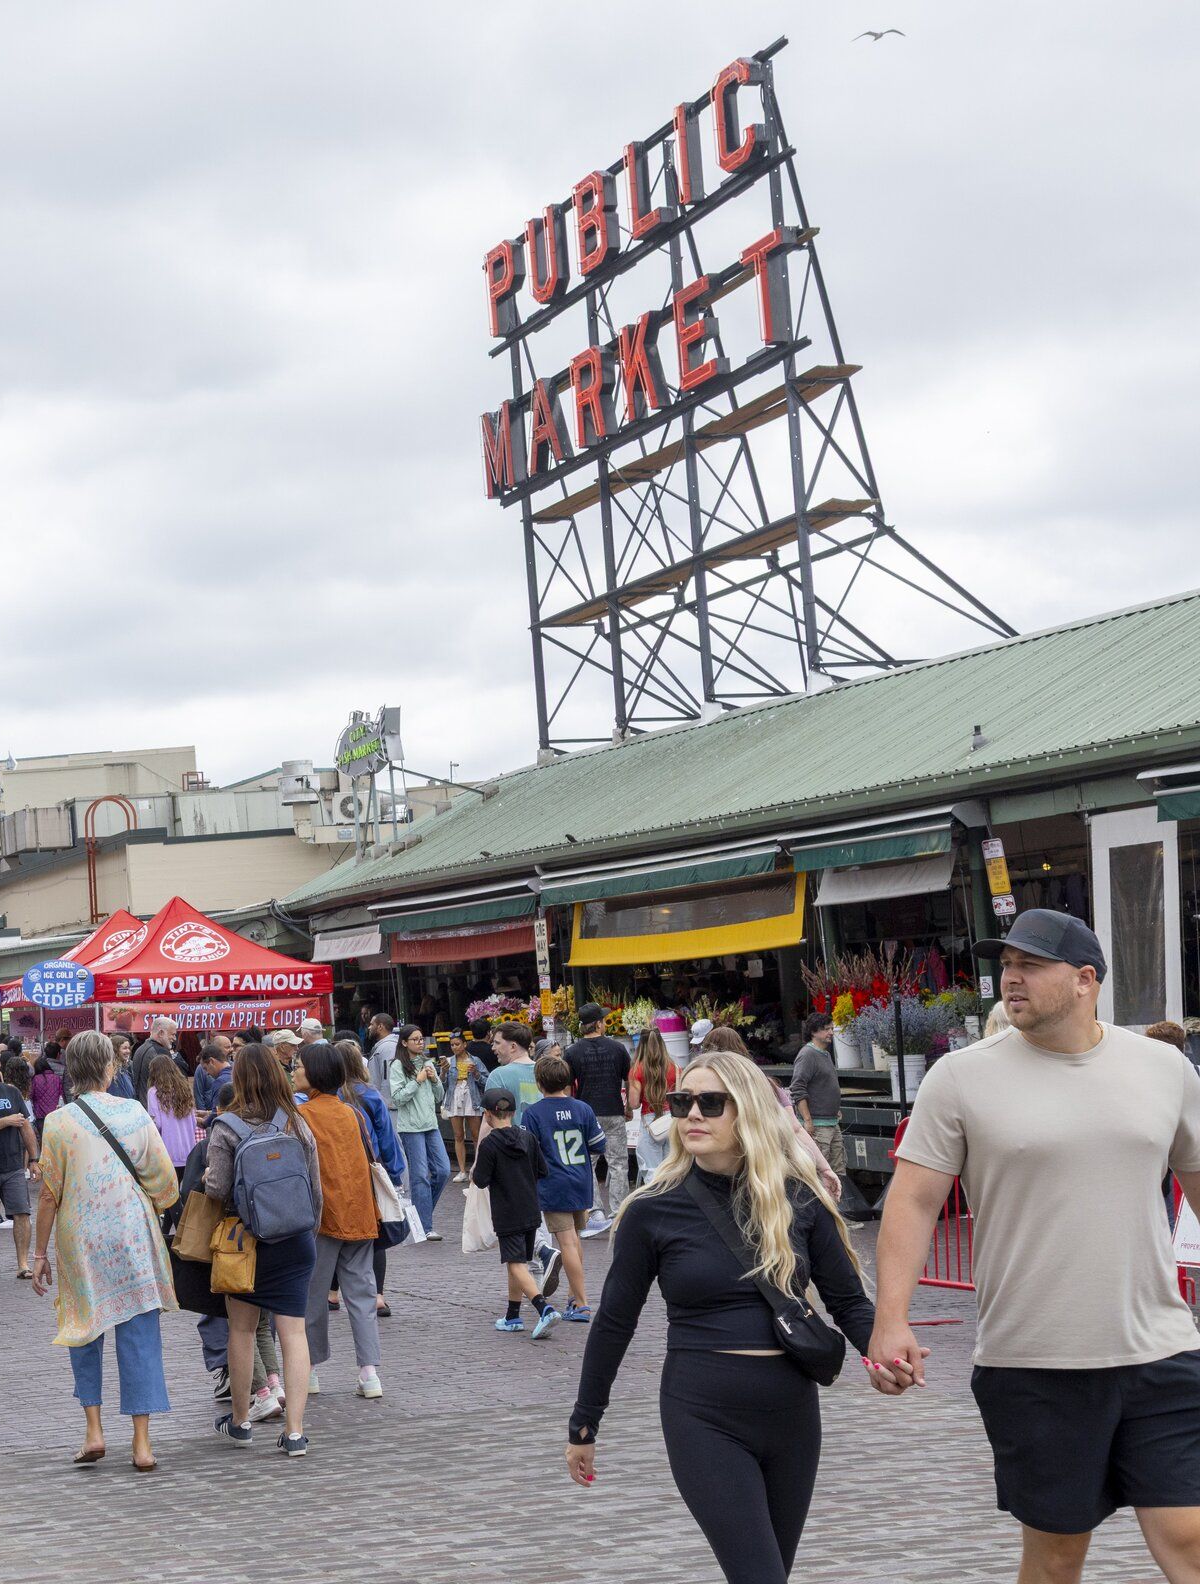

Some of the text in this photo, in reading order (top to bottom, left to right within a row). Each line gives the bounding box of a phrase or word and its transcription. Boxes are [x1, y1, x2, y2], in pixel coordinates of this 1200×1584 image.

[484, 56, 770, 338] PUBLIC
[480, 226, 792, 500] MARKET
[166, 923, 219, 941] TINY'S
[174, 951, 224, 961] ORGANIC
[43, 961, 76, 969] ORGANIC
[43, 971, 55, 979] ICE
[56, 971, 74, 979] COLD
[32, 982, 86, 993] APPLE
[148, 975, 225, 994] WORLD
[229, 973, 314, 991] FAMOUS
[32, 993, 85, 1007] CIDER
[179, 1001, 271, 1011] Organic Cold Pressed
[143, 1009, 308, 1030] STWBERRY APPLE CIDER
[555, 1110, 572, 1121] FAN
[553, 1129, 586, 1166] 12
[1180, 1242, 1200, 1252] PROPER
